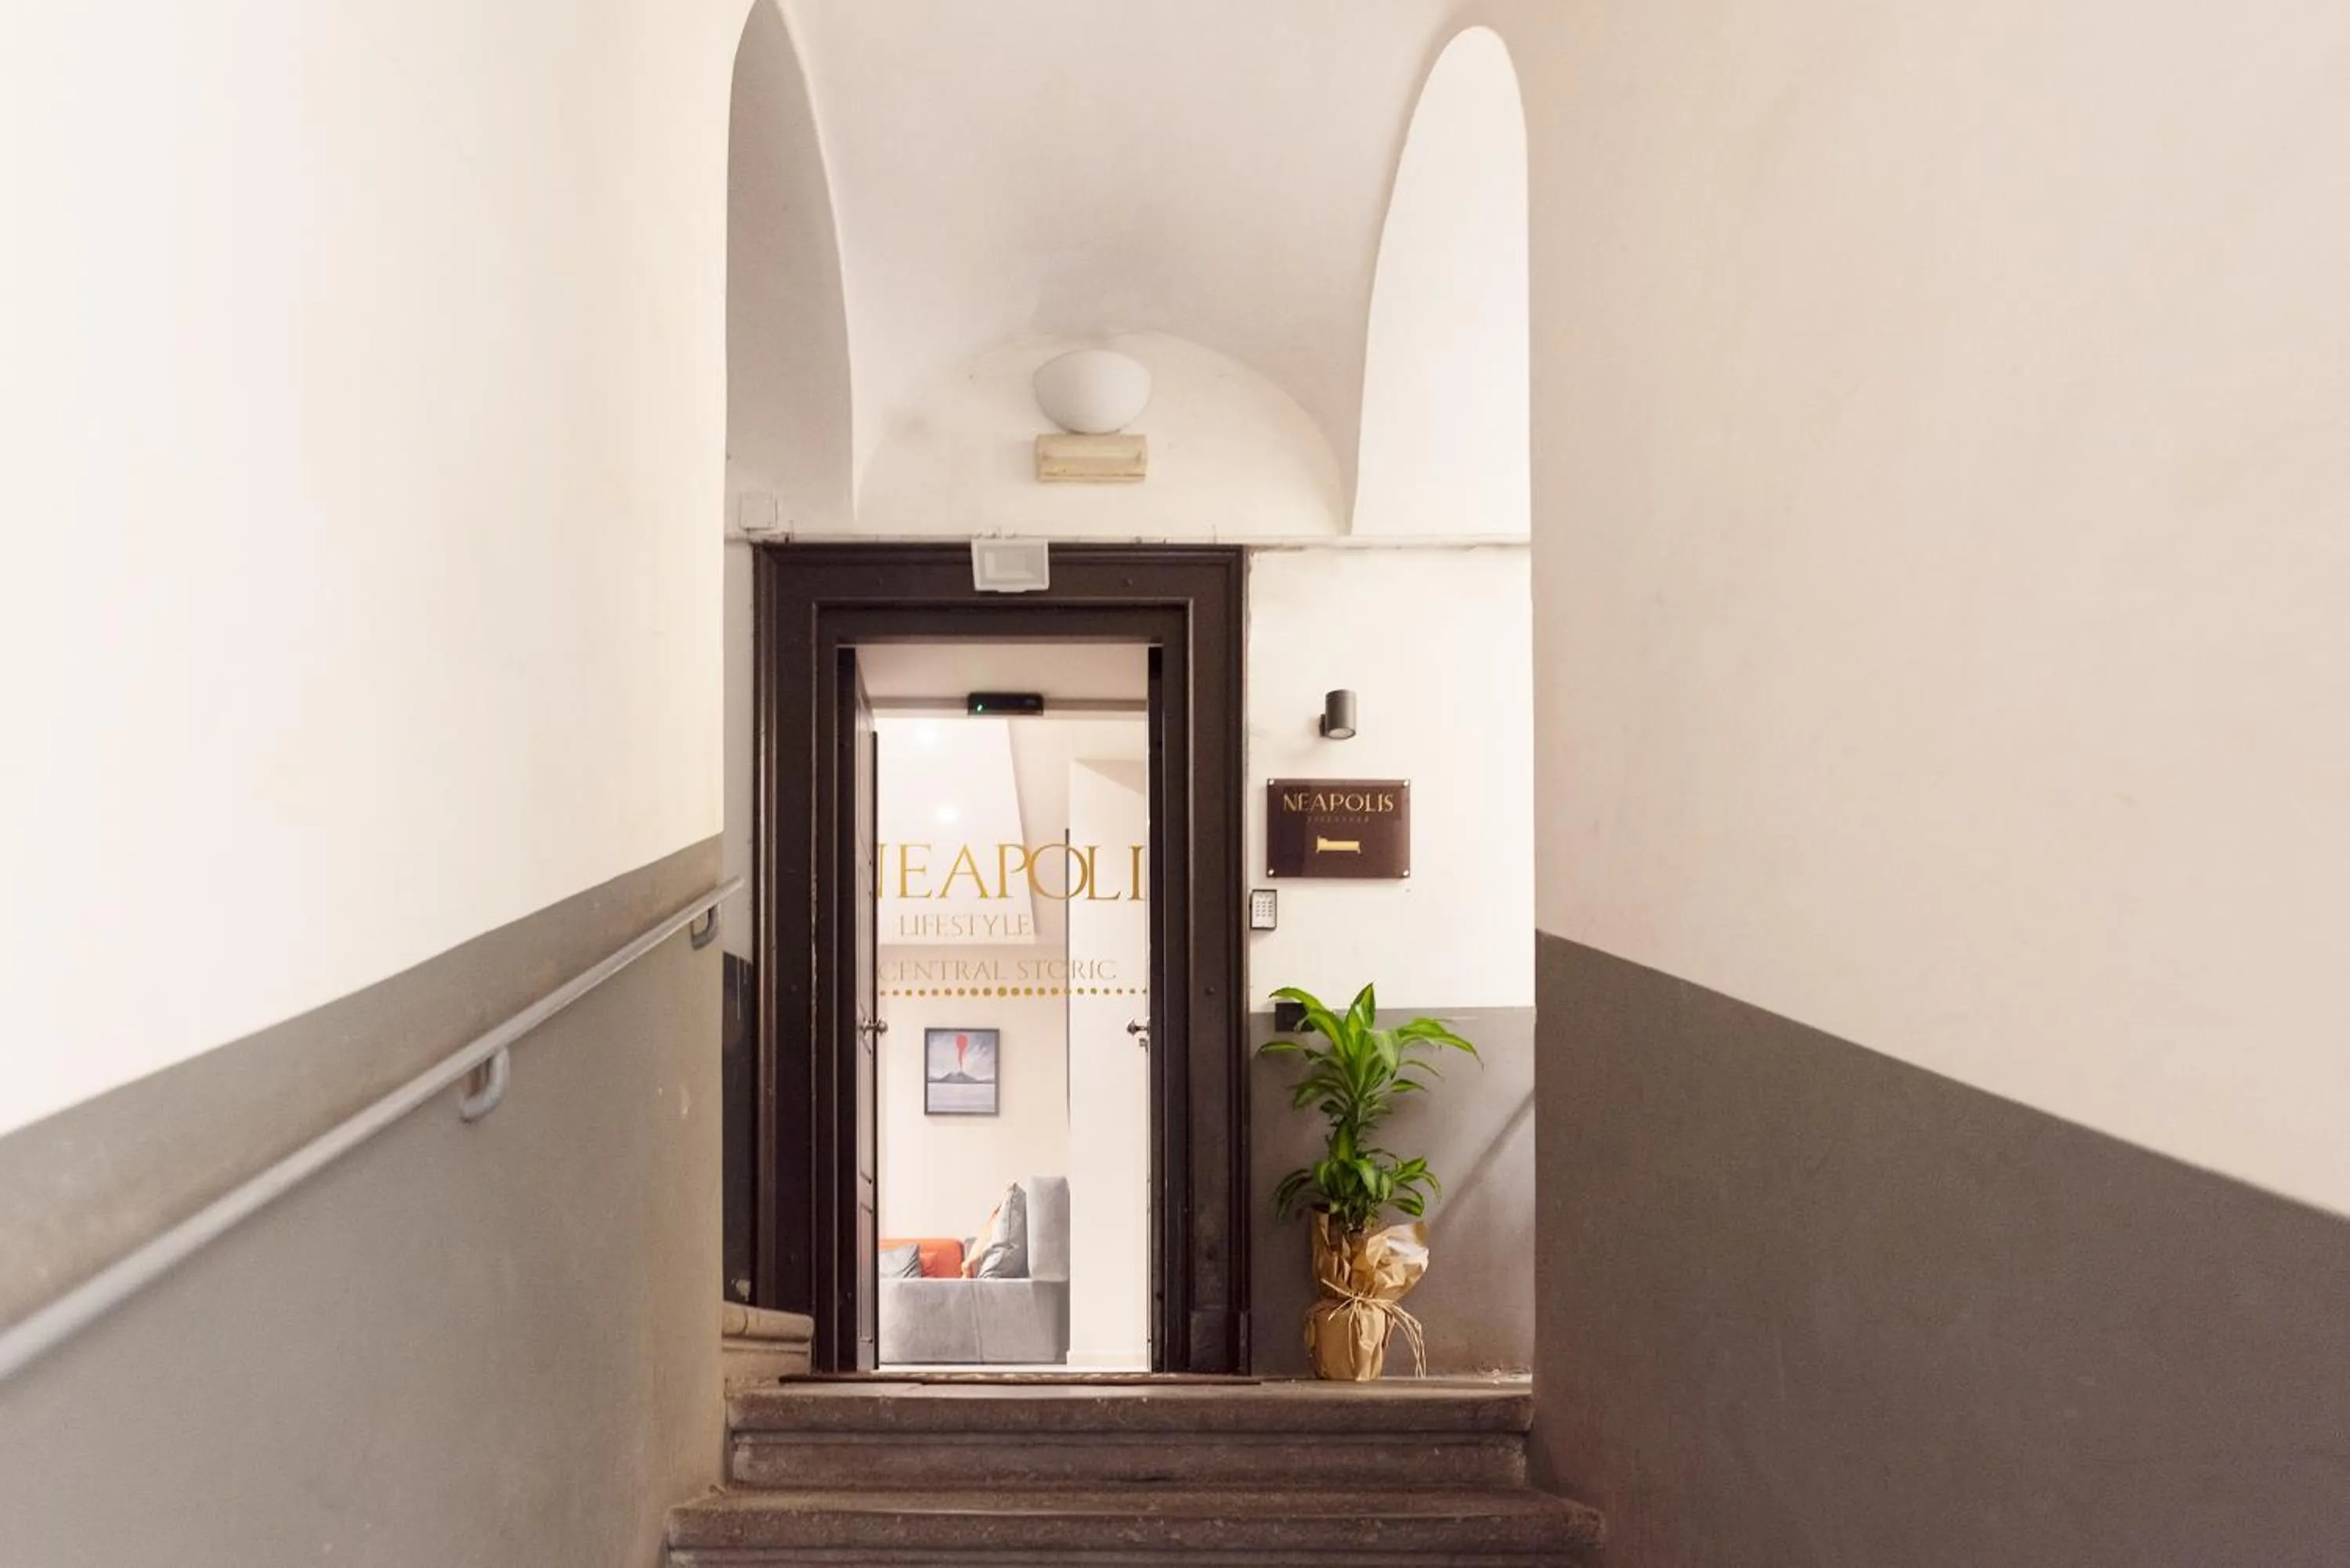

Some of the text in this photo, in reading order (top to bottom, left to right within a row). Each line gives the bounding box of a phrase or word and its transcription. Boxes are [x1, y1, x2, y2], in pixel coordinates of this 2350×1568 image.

[1282, 793, 1394, 812] NEAPOLIS
[877, 843, 1146, 900] EAPOLI
[899, 913, 1032, 936] LIFESTYLE
[878, 959, 1116, 981] CENTRAL STORIC
